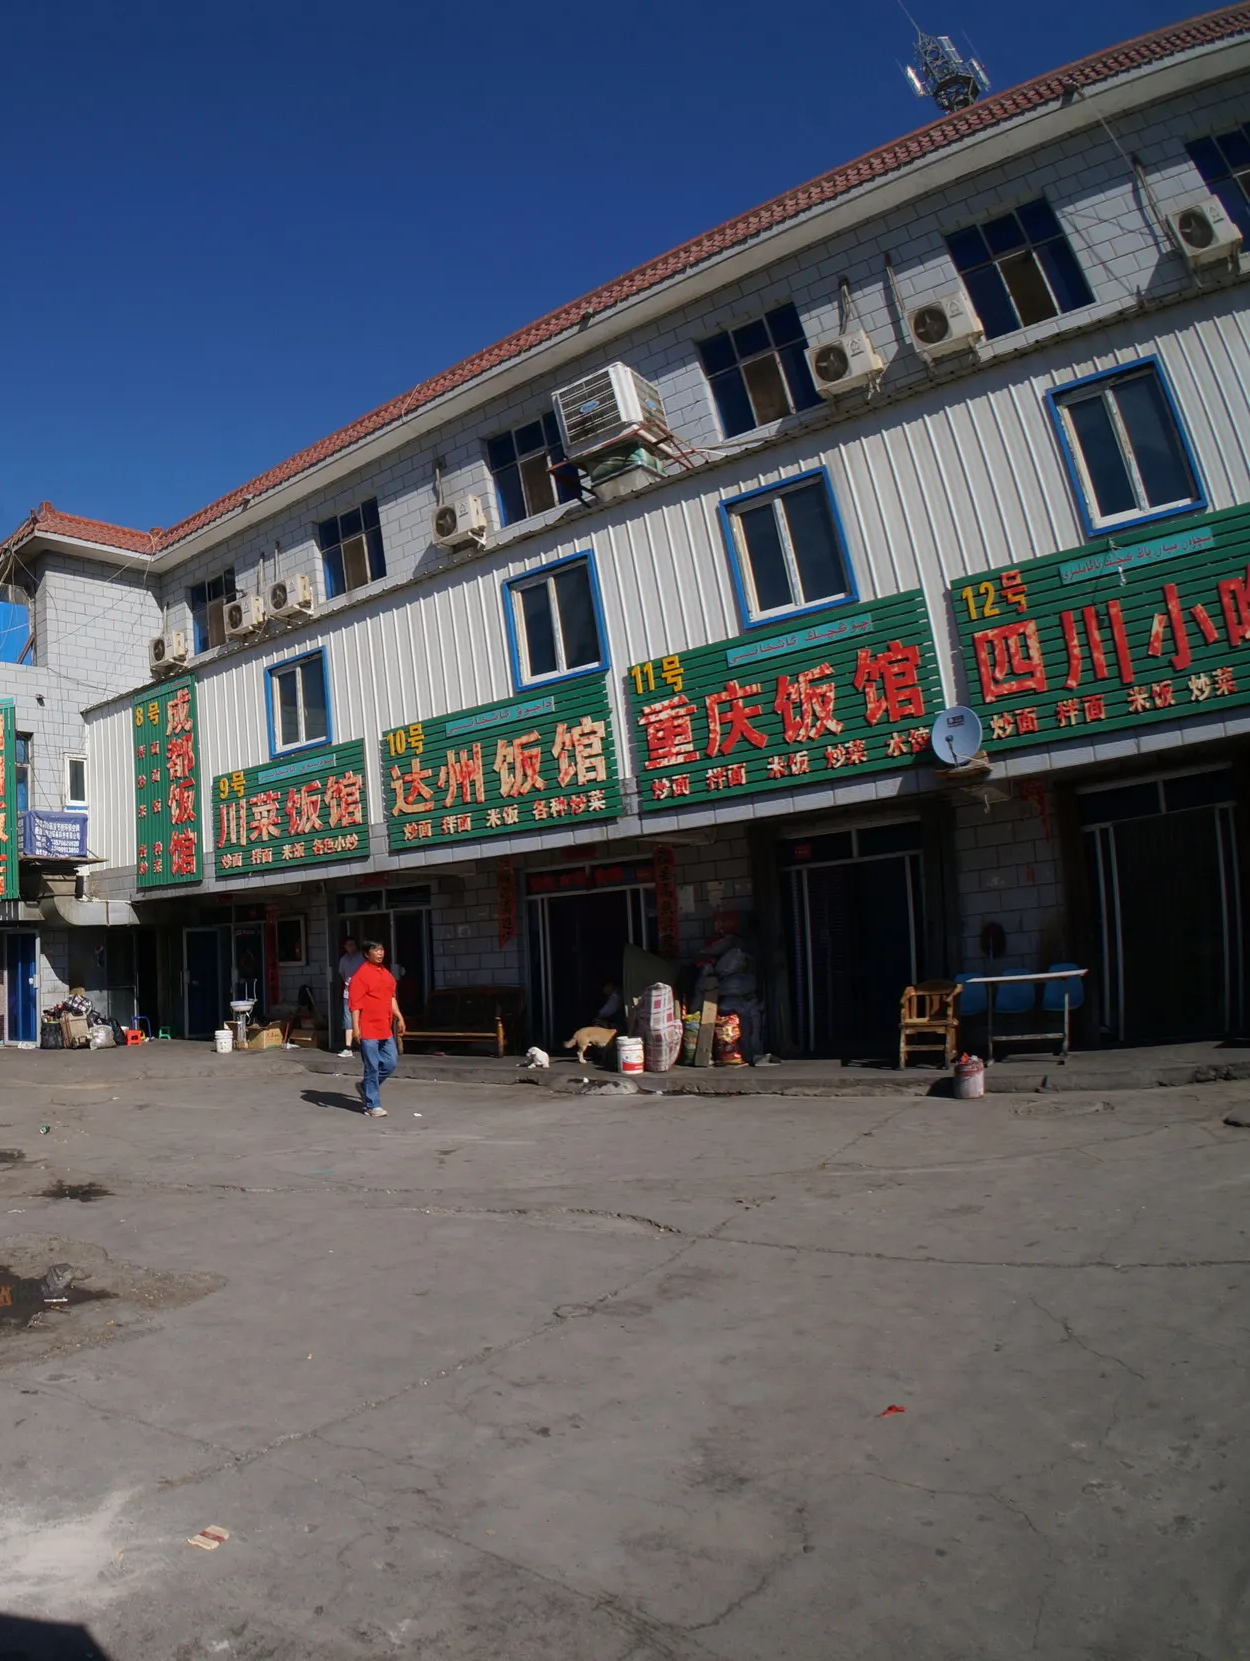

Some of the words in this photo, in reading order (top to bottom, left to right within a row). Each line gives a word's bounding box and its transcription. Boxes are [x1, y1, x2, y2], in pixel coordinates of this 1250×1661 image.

[962, 569, 1027, 620] 12号
[631, 655, 684, 693] 11号
[135, 701, 160, 727] 8号
[638, 639, 925, 769] 重庆饭馆
[990, 707, 1037, 739] 炒面
[1056, 694, 1105, 726] 拌面
[1127, 680, 1175, 713] 米饭
[1188, 667, 1237, 701] 炒菜
[386, 723, 424, 757] 10号
[390, 715, 606, 816] 达州饭馆
[166, 688, 197, 876] 成都饭馆
[219, 771, 245, 799] 9号
[652, 773, 690, 800] 炒面
[706, 762, 747, 791] 拌面
[767, 751, 810, 779] 米饭
[825, 740, 867, 768] 炒菜
[217, 770, 362, 848] 川菜饭馆
[403, 819, 432, 841] 炒面
[441, 813, 472, 834] 拌面
[486, 804, 519, 828] 米饭
[533, 790, 606, 820] 各种炒菜
[221, 852, 242, 869] 炒面
[251, 848, 273, 864] 拌面
[282, 842, 305, 860] 米饭
